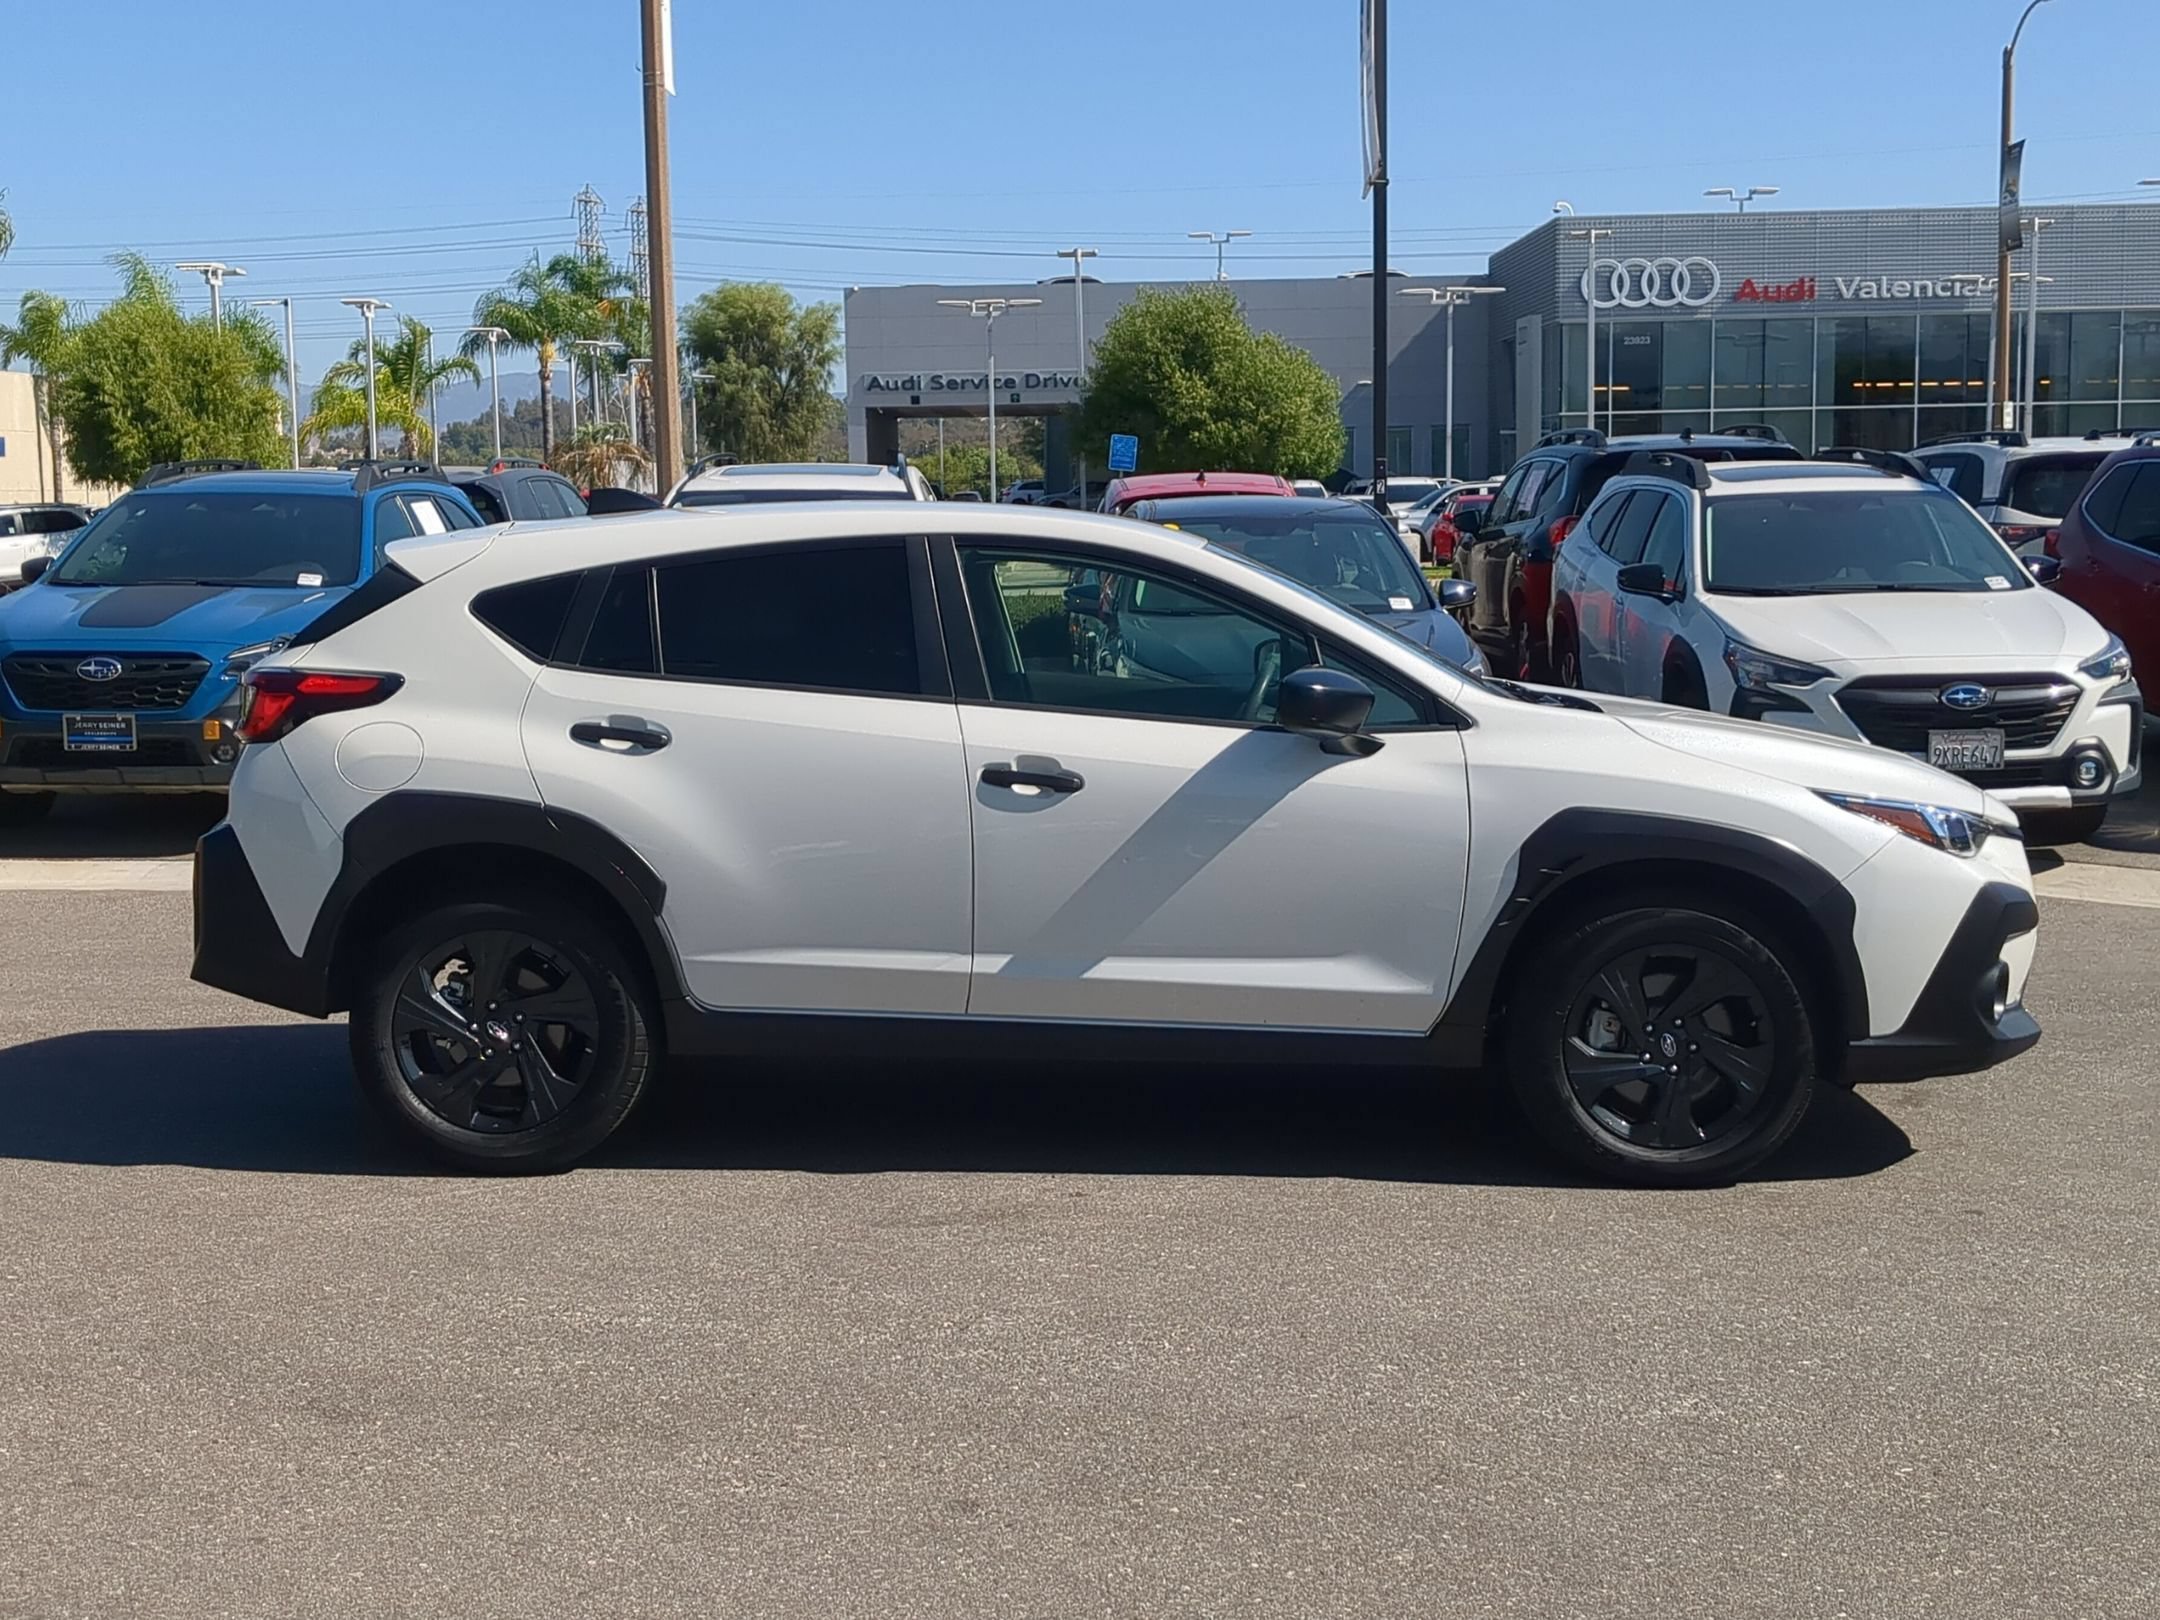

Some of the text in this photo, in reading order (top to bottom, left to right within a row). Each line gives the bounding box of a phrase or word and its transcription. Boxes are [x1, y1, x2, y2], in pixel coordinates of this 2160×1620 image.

[1736, 276, 1981, 301] Audi Valencia
[867, 375, 922, 391] Audi
[930, 374, 1016, 391] Service
[1934, 746, 1998, 765] 9KRE647
